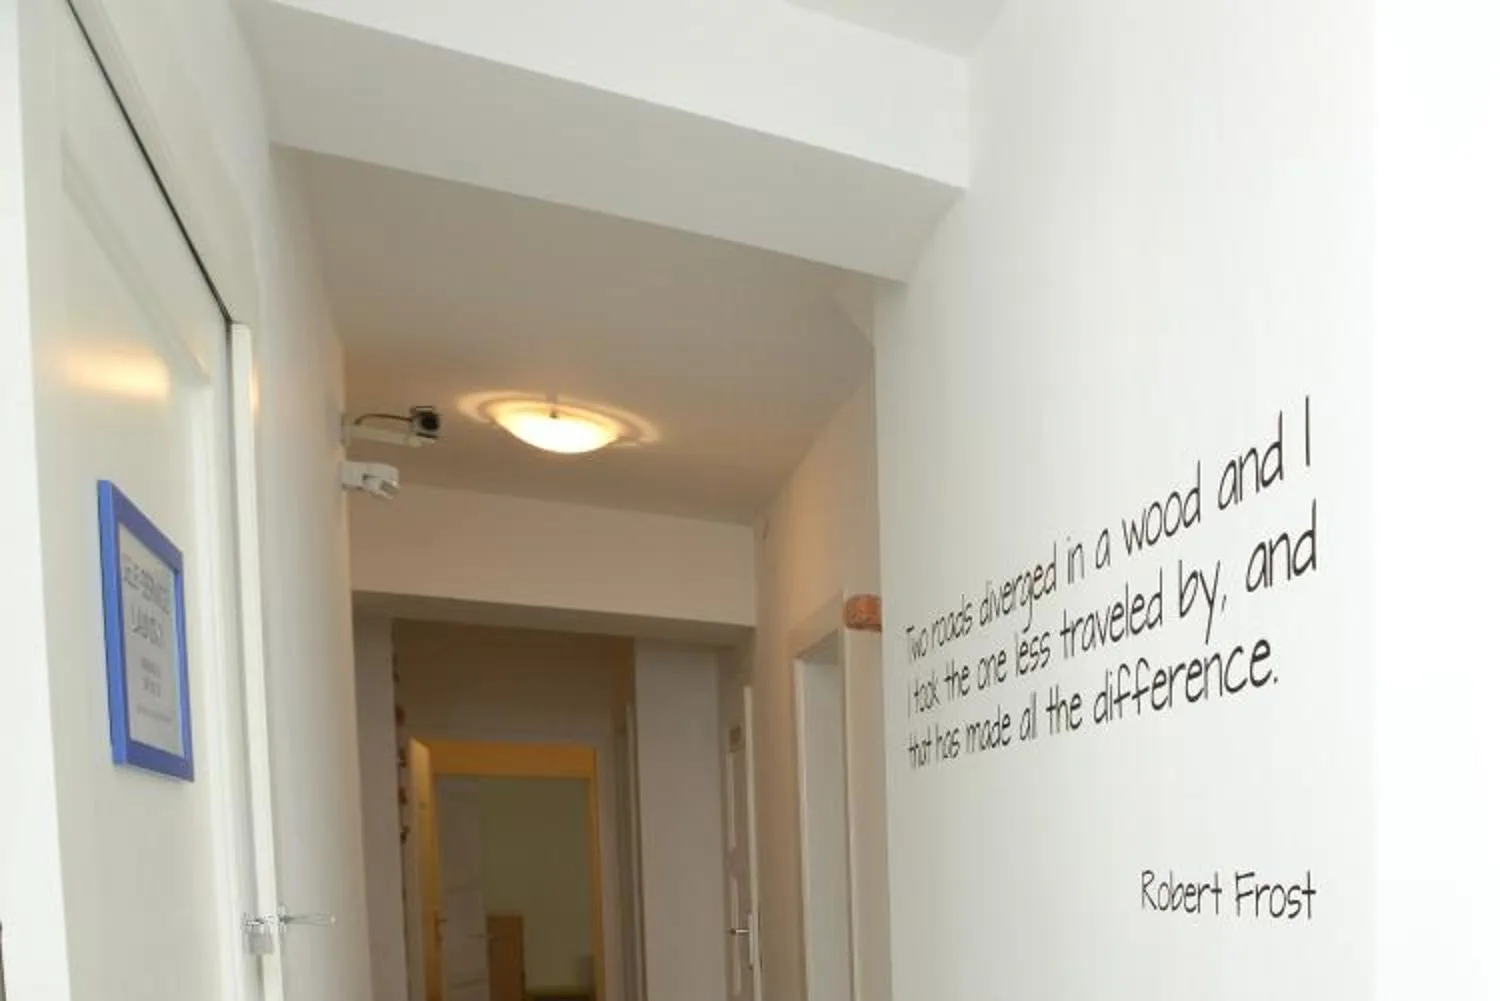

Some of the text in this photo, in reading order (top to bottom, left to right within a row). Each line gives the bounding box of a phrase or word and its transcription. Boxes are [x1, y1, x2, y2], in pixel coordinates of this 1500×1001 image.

[906, 625, 927, 663] Two
[931, 593, 972, 649] roads
[979, 541, 1056, 634] diverged
[1066, 536, 1084, 585] in
[1095, 528, 1110, 570] a
[1122, 459, 1200, 556] wood
[1217, 410, 1283, 511] and
[914, 670, 940, 713] took
[944, 658, 970, 702] the
[977, 650, 1007, 690] one
[1015, 630, 1050, 678] less
[1060, 566, 1163, 661] traveled
[1177, 559, 1227, 645] by,
[1245, 497, 1317, 593] and
[908, 638, 1279, 770] that has made all the difference.
[1140, 869, 1317, 918] Robert Frost
